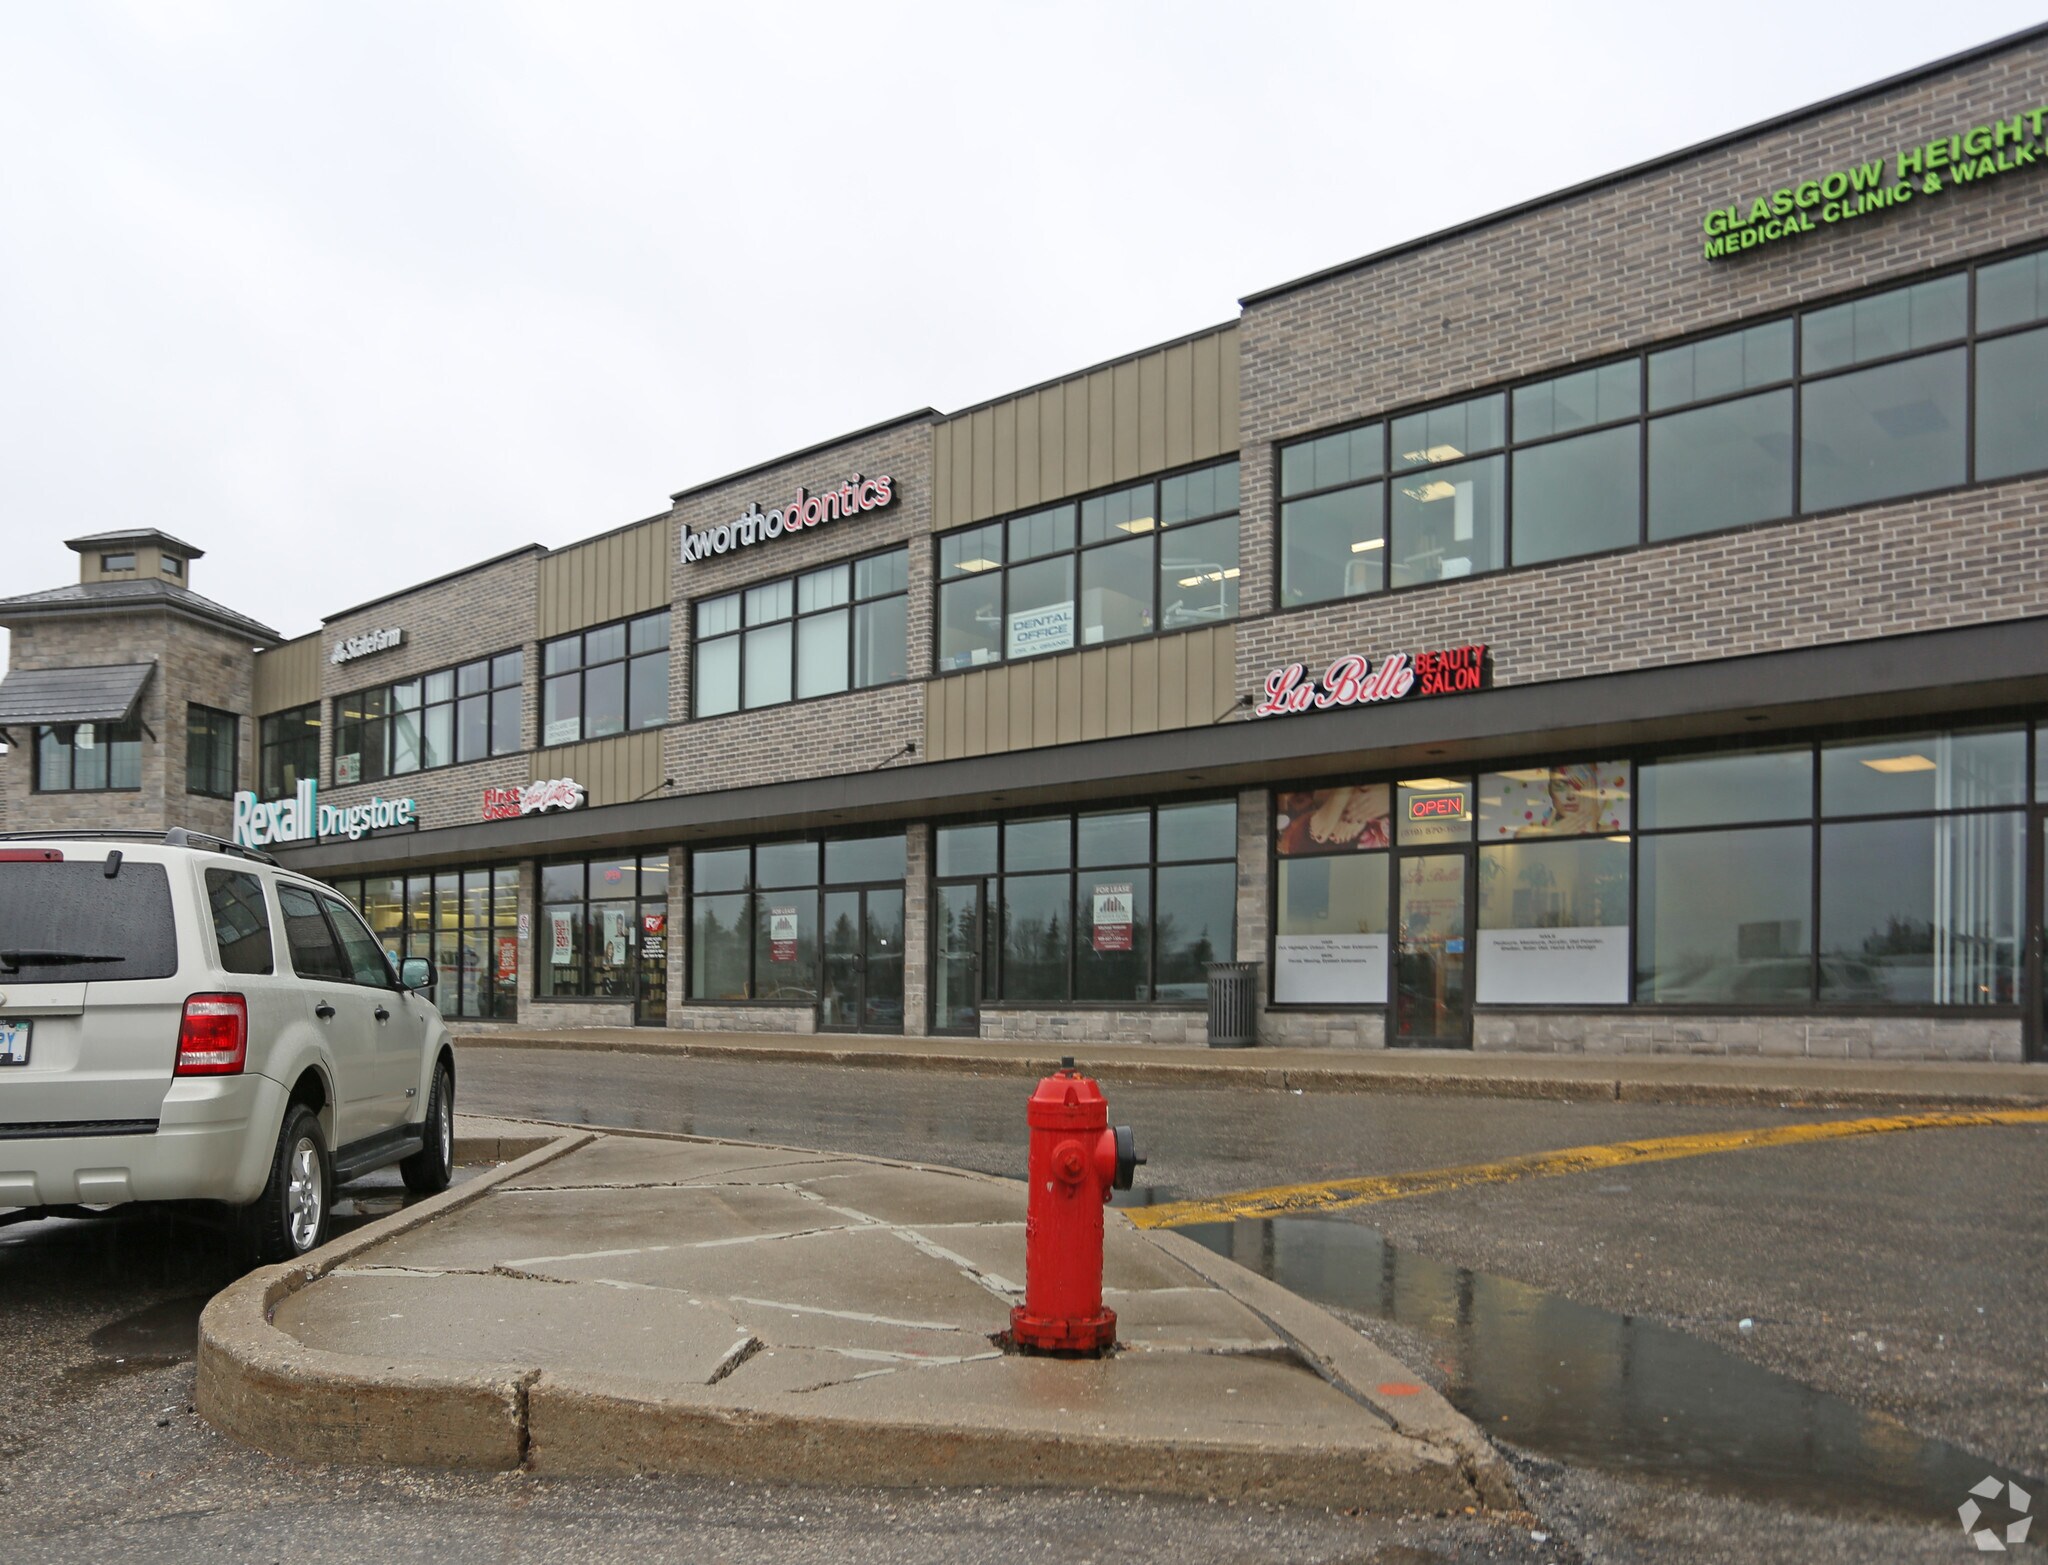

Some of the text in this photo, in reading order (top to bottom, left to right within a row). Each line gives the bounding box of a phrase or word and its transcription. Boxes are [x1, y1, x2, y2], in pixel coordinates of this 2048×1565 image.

[1703, 105, 2048, 236] GLASGOW HEIGHT
[1704, 211, 1816, 260] MEDICAL
[1822, 181, 1913, 223] CLINIC
[1922, 171, 1943, 195] &
[680, 472, 892, 564] kworthodontics
[1013, 612, 1072, 631] DENTAL
[1017, 624, 1067, 642] OFFICE
[1415, 643, 1486, 675] BEAUTY
[1256, 653, 1415, 717] La Belle
[1420, 666, 1481, 695] SALON
[484, 788, 520, 805] First
[1412, 797, 1461, 817] OPEN
[232, 778, 414, 850] Rexall Drugstore
